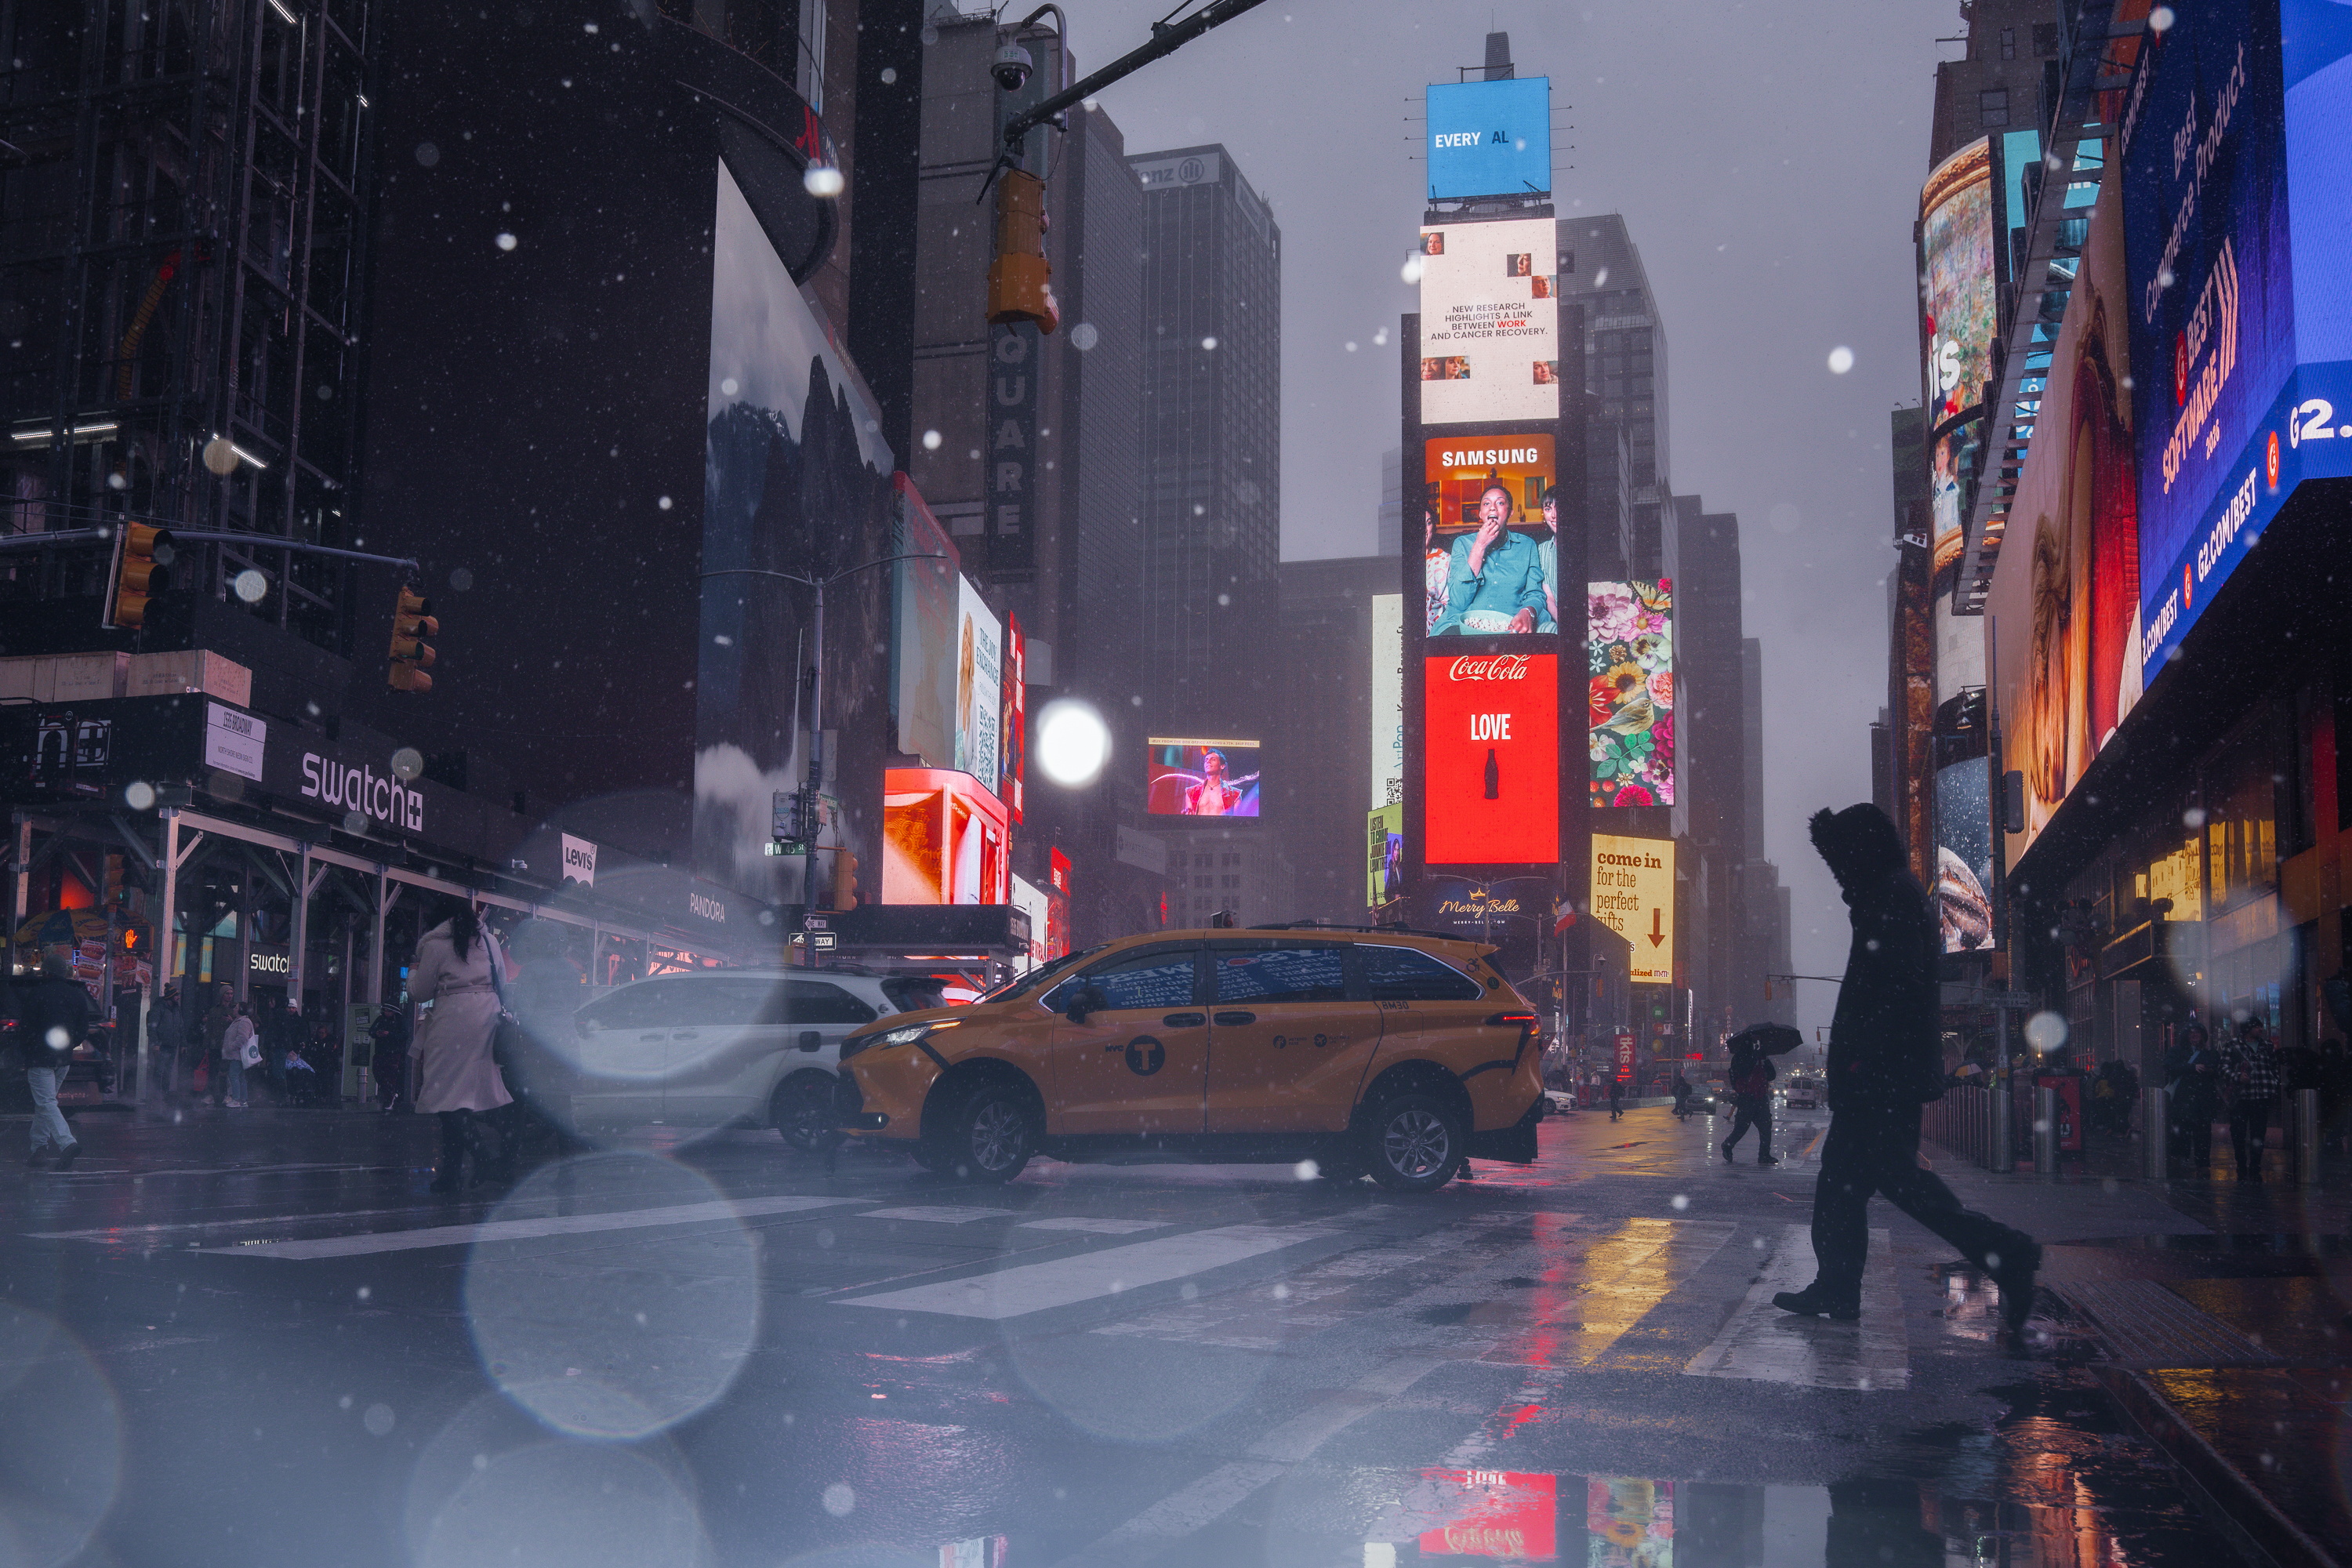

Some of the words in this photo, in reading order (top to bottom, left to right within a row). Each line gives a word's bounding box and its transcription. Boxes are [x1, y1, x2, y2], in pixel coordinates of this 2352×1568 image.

[1436, 132, 1481, 148] EVERY
[1492, 131, 1509, 143] AL
[2174, 89, 2196, 181] Best
[1137, 167, 1174, 184] anz
[2146, 181, 2194, 325] Commerce
[2196, 39, 2245, 196] Product
[1445, 313, 1501, 322] HIGHLIGHTS
[1513, 310, 1533, 319] LINK
[1452, 305, 1473, 314] NEW
[1476, 303, 1525, 312] RESEARCH
[1452, 321, 1494, 330] BETWEEN
[1497, 320, 1526, 328] WORK
[1454, 330, 1493, 339] CANCER
[1496, 328, 1548, 337] RECOVERY.
[2187, 273, 2212, 371] BEST
[2163, 349, 2218, 494] SOFTWARE
[2206, 419, 2220, 460] 2026
[1442, 448, 1538, 467] SAMSUNG
[2198, 467, 2256, 583] G2.COM/BEST
[977, 646, 999, 687] EXCHANGE
[1449, 654, 1531, 681] Coca-Cola
[1471, 713, 1512, 740] LOVE
[301, 752, 405, 826] swatch
[775, 845, 782, 855] W
[786, 845, 795, 854] 45
[1598, 853, 1642, 868] come
[1644, 852, 1662, 869] in
[1597, 866, 1613, 885] for
[1617, 869, 1636, 887] the
[691, 893, 724, 924] PANDORA
[1439, 900, 1485, 918] Merry
[1488, 899, 1519, 913] Belle
[1596, 891, 1639, 913] perfect
[1381, 1000, 1410, 1010] 8M30
[1134, 1044, 1156, 1071] T
[1620, 1036, 1632, 1064] tkts
